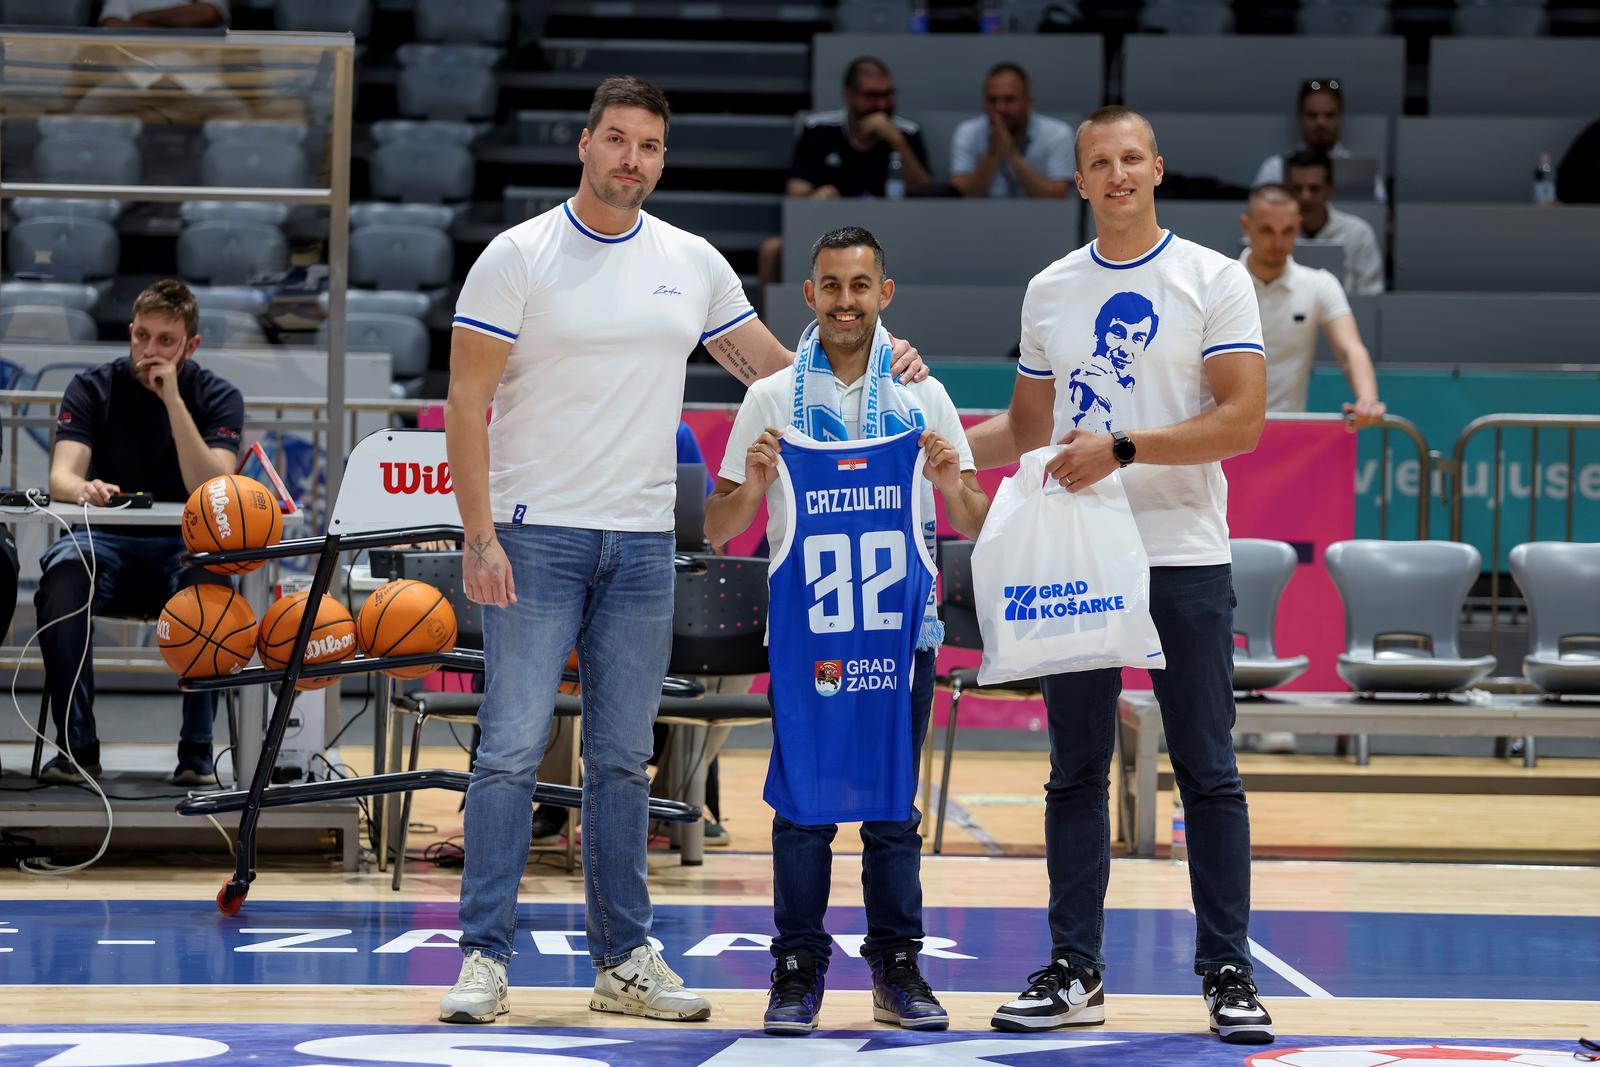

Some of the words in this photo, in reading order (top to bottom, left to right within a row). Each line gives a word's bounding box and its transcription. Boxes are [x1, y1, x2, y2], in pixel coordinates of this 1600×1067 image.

[790, 348, 809, 434] ŠARKAŠKI
[805, 485, 902, 515] CAZZULANI
[1038, 580, 1089, 600] GRAD
[1040, 595, 1126, 619] KOŠARKE
[846, 658, 897, 675] GRAD
